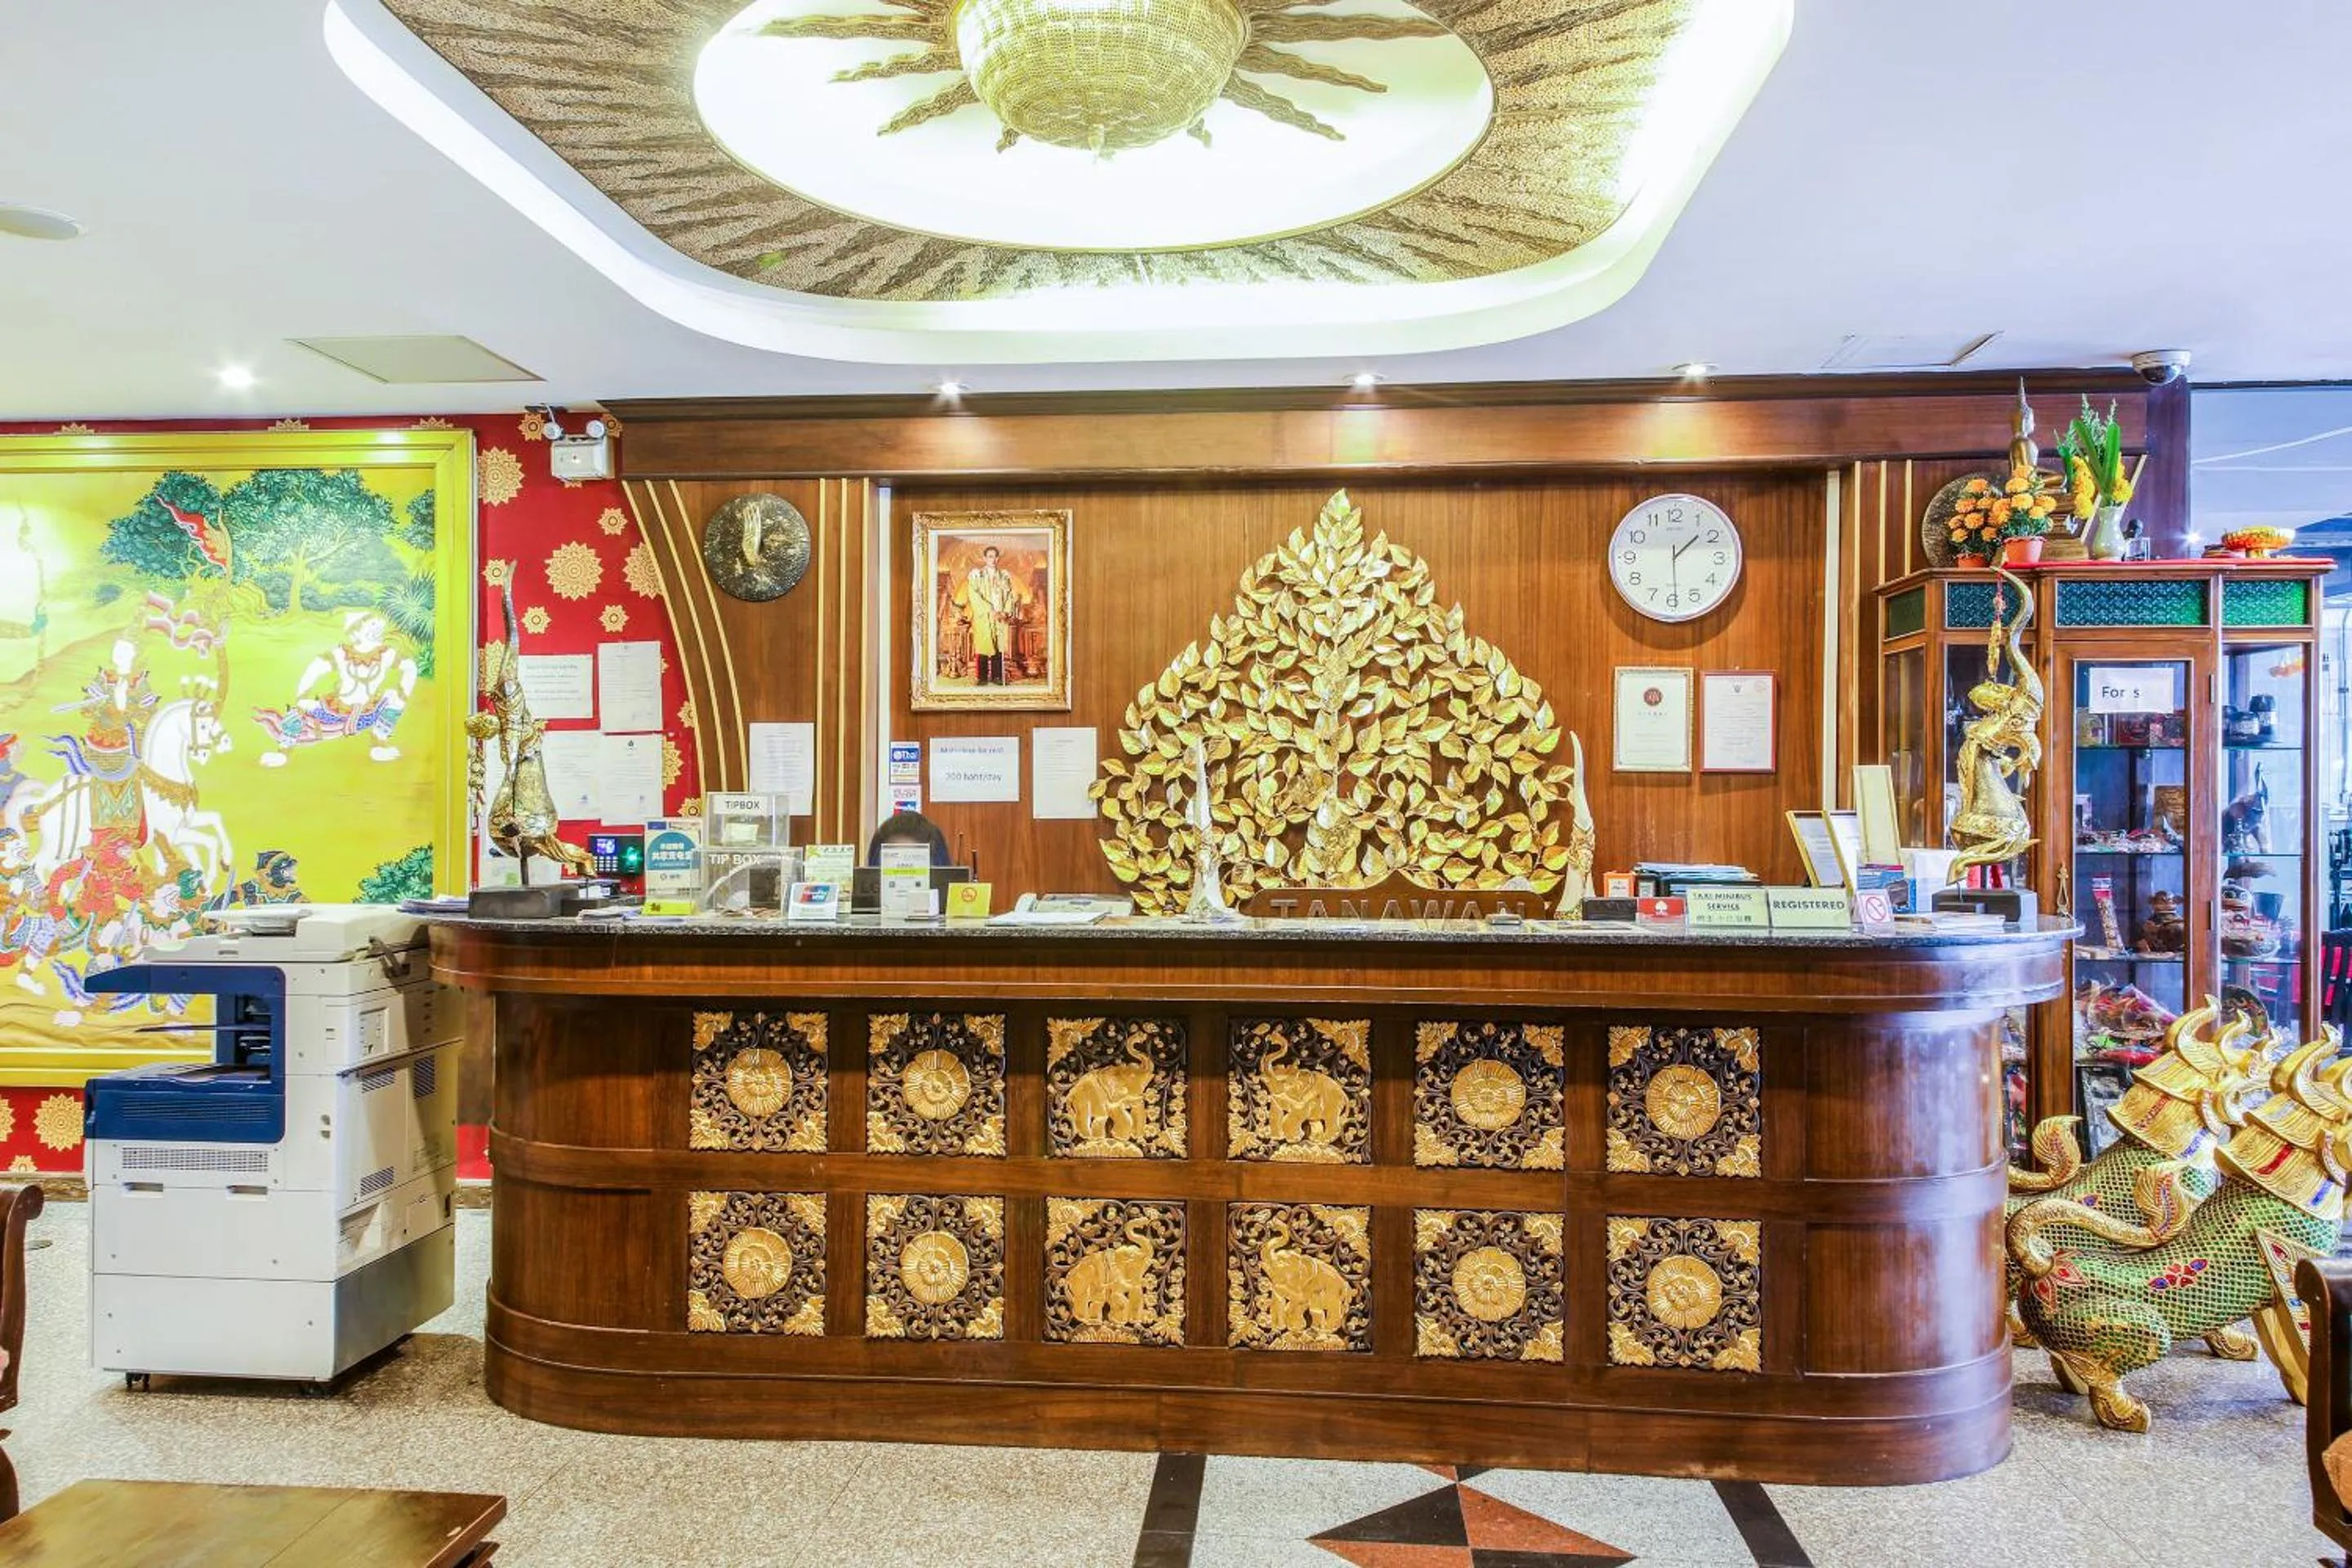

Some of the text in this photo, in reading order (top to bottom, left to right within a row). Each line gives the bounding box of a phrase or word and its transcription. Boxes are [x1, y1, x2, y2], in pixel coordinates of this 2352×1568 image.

[1648, 514, 1659, 527] 11
[1666, 509, 1683, 523] 12
[1695, 514, 1700, 527] 1
[1630, 531, 1646, 544] 10
[1707, 530, 1719, 543] 2
[1624, 550, 1637, 564] 9
[1713, 551, 1726, 565] 3
[1629, 572, 1641, 585] 8
[1705, 572, 1717, 587] 4
[1647, 588, 1658, 601] 7
[1666, 594, 1679, 608] 6
[1688, 589, 1700, 602] 5
[2101, 686, 2125, 698] For
[725, 800, 760, 809] TIPBOX
[708, 854, 760, 865] TIP BOX
[1772, 901, 1845, 910] REGISTERED
